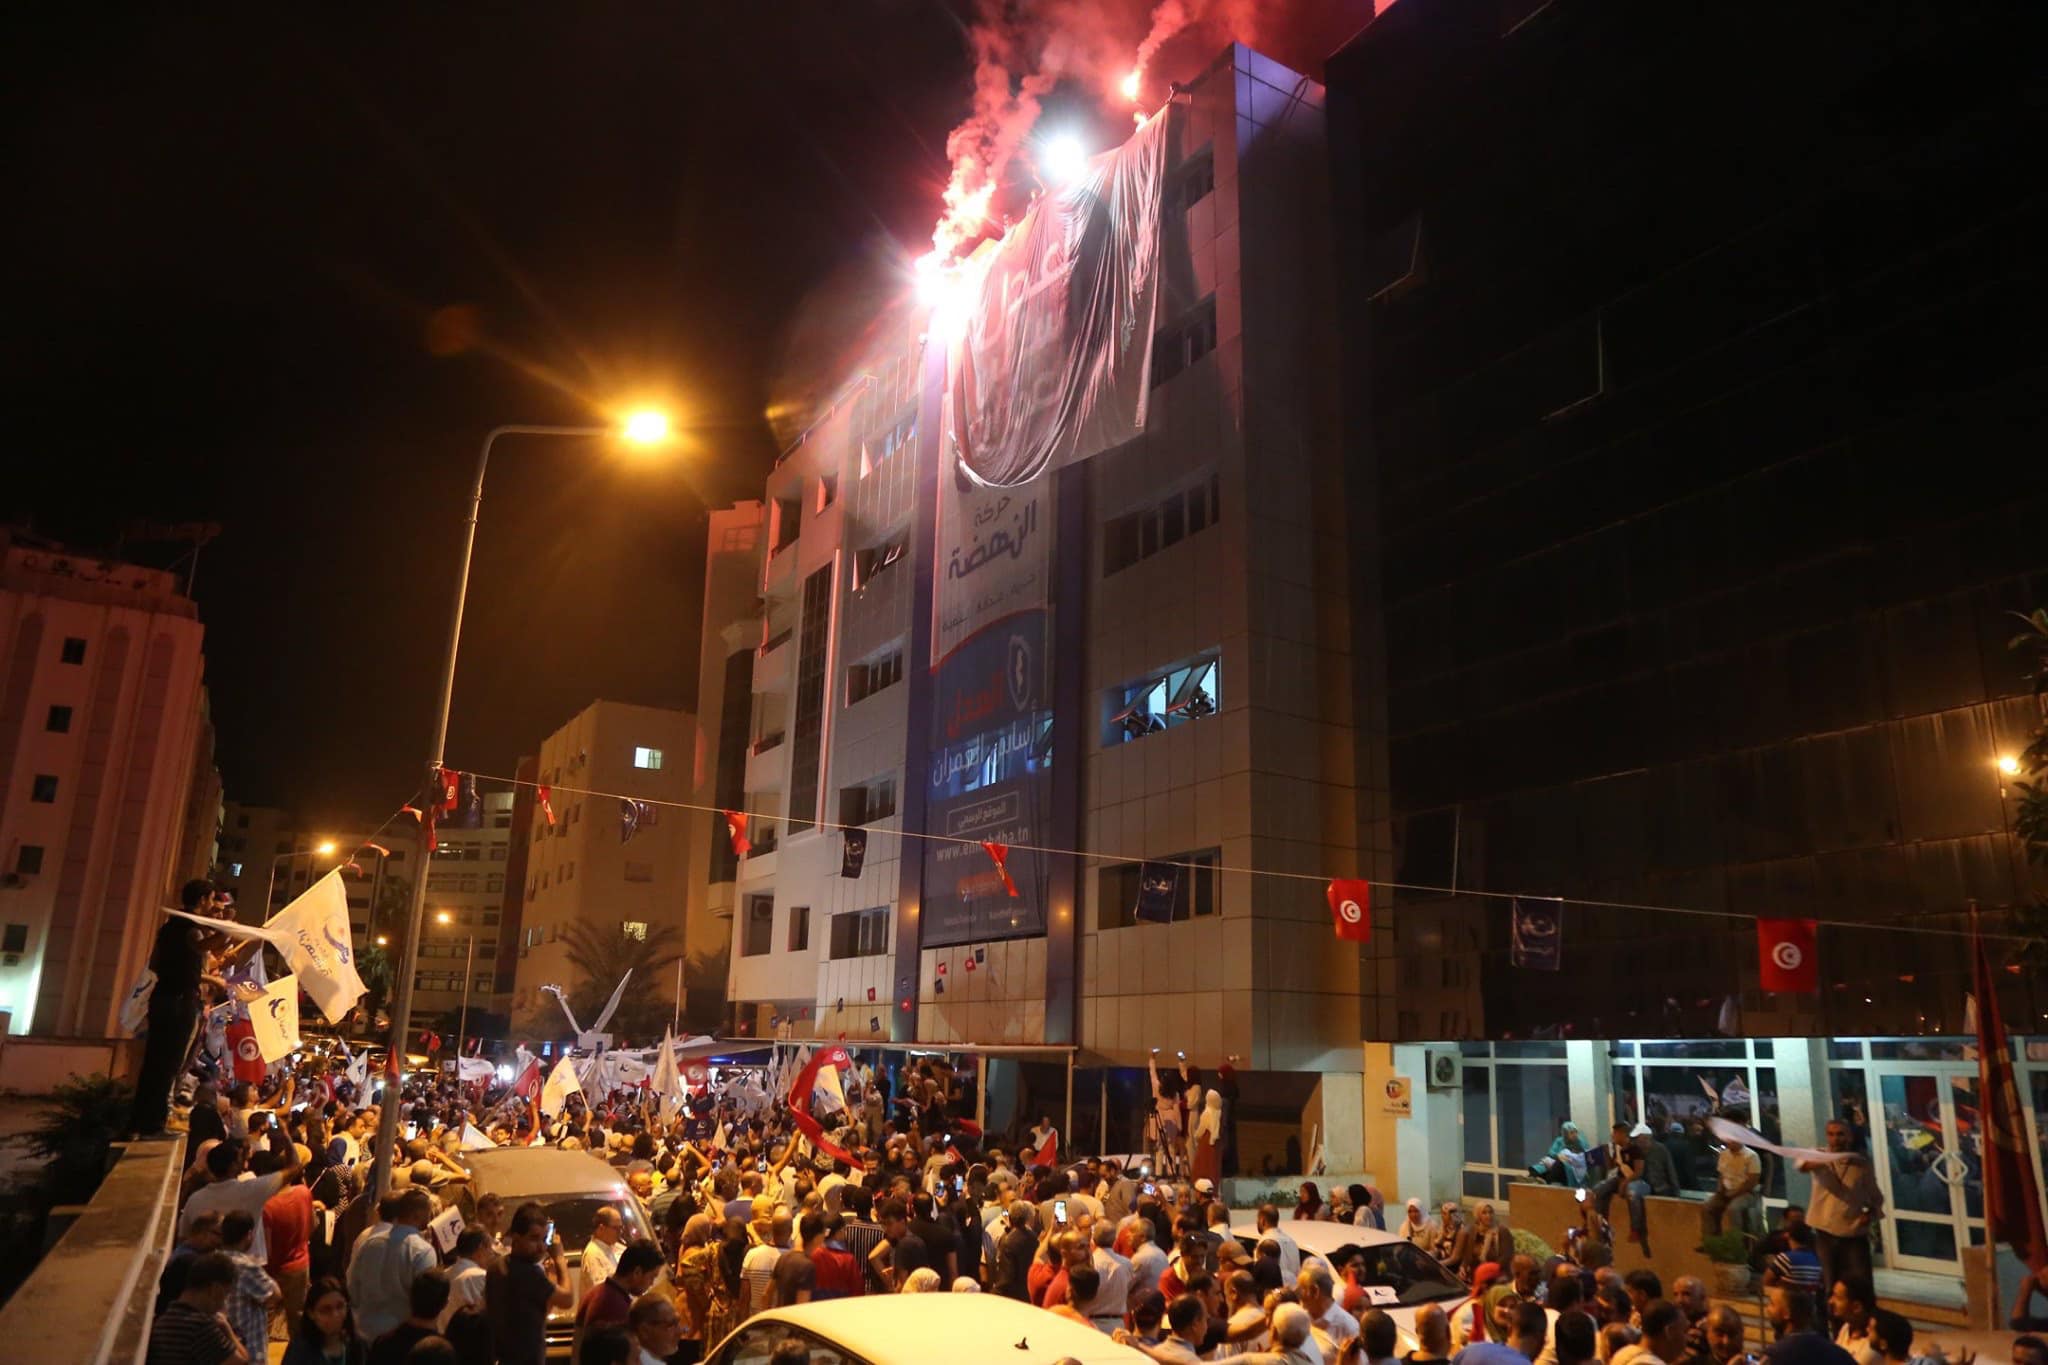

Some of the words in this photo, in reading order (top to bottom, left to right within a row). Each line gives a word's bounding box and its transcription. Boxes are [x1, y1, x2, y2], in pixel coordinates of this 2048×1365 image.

[948, 499, 1037, 580] النهضة
[974, 496, 1011, 528] حركة
[933, 732, 985, 787] العمران
